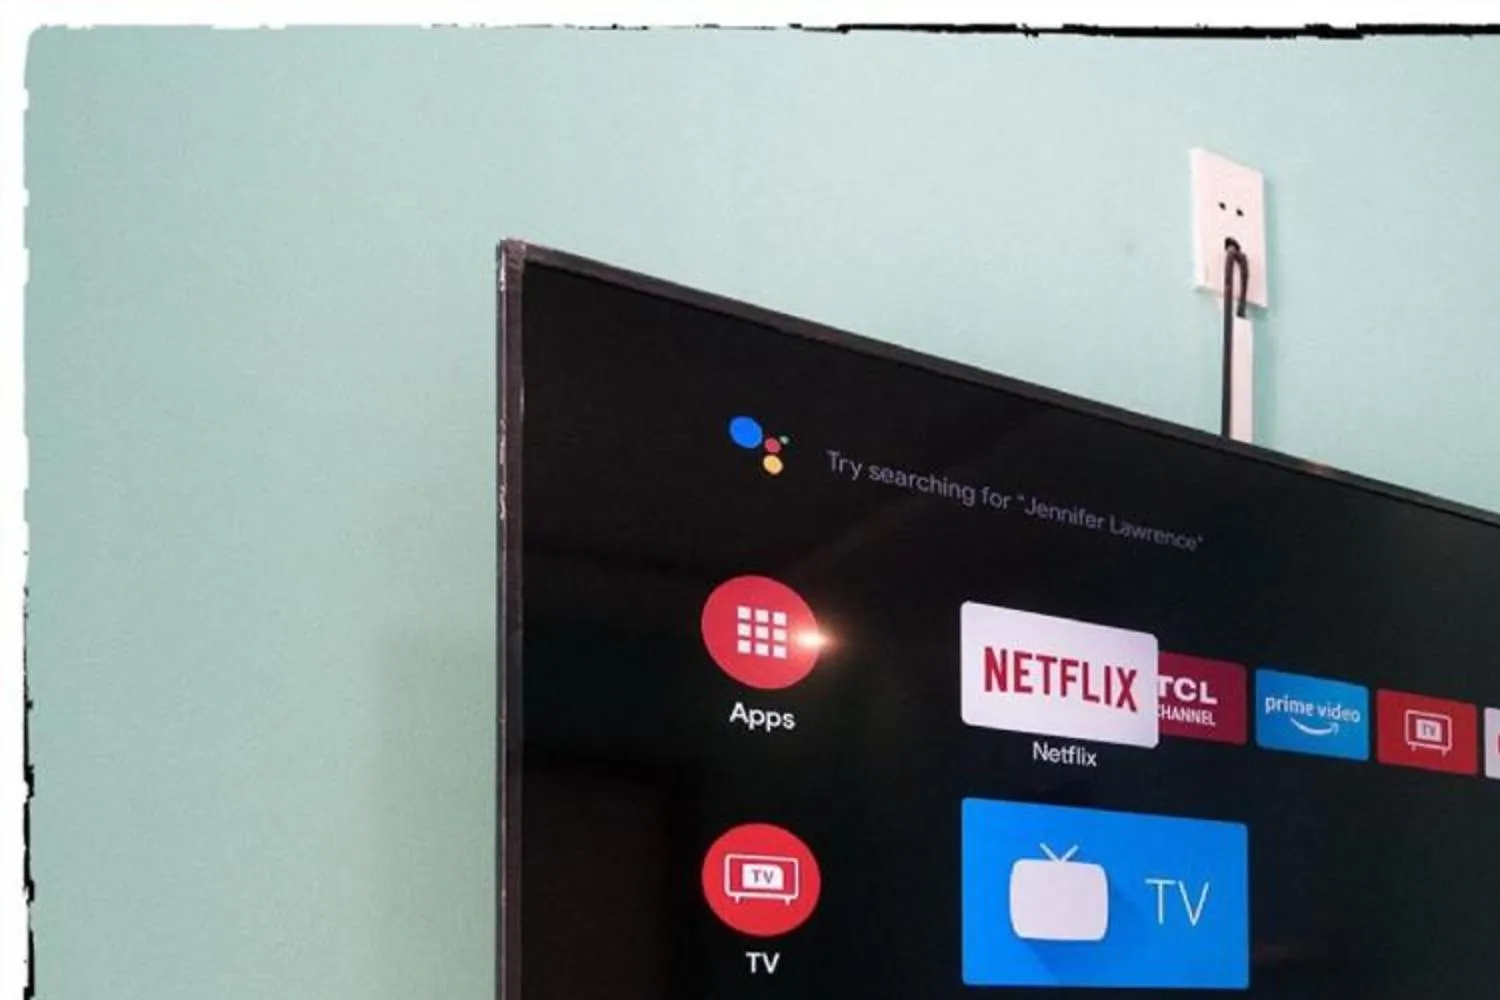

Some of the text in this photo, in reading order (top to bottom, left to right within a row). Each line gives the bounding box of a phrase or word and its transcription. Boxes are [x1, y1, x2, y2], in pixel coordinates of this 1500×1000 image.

[826, 450, 863, 480] Try
[867, 463, 975, 506] searching
[981, 486, 1011, 510] for
[983, 646, 1138, 712] NETFLIX
[1158, 674, 1218, 705] TCL
[729, 701, 796, 731] Apps
[1265, 695, 1361, 724] prime video
[1421, 723, 1438, 738] TV
[1031, 740, 1098, 767] Netflix
[750, 867, 775, 886] TV
[1145, 877, 1209, 927] TV
[745, 951, 781, 975] TV
